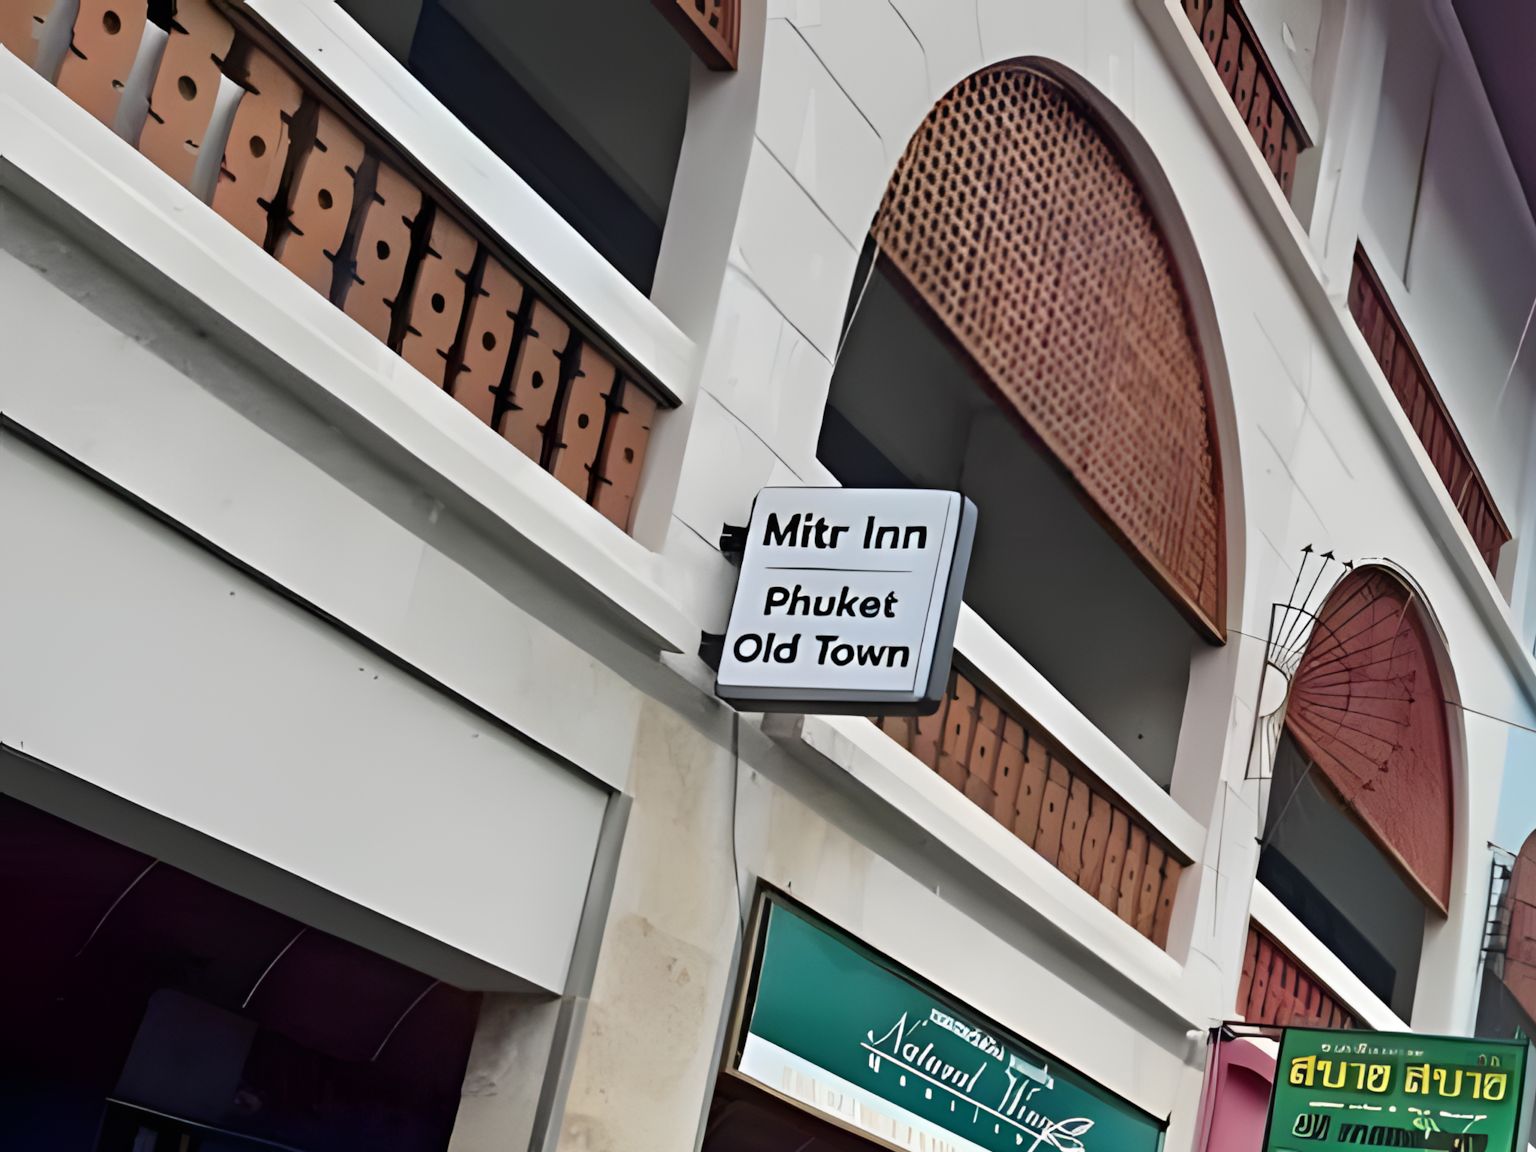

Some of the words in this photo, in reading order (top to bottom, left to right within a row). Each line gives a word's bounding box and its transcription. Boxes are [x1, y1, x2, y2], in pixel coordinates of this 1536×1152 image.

[763, 512, 850, 549] Mitr
[863, 515, 928, 549] Inn
[763, 584, 898, 618] Phuket
[733, 632, 802, 663] Old
[815, 634, 910, 668] Town
